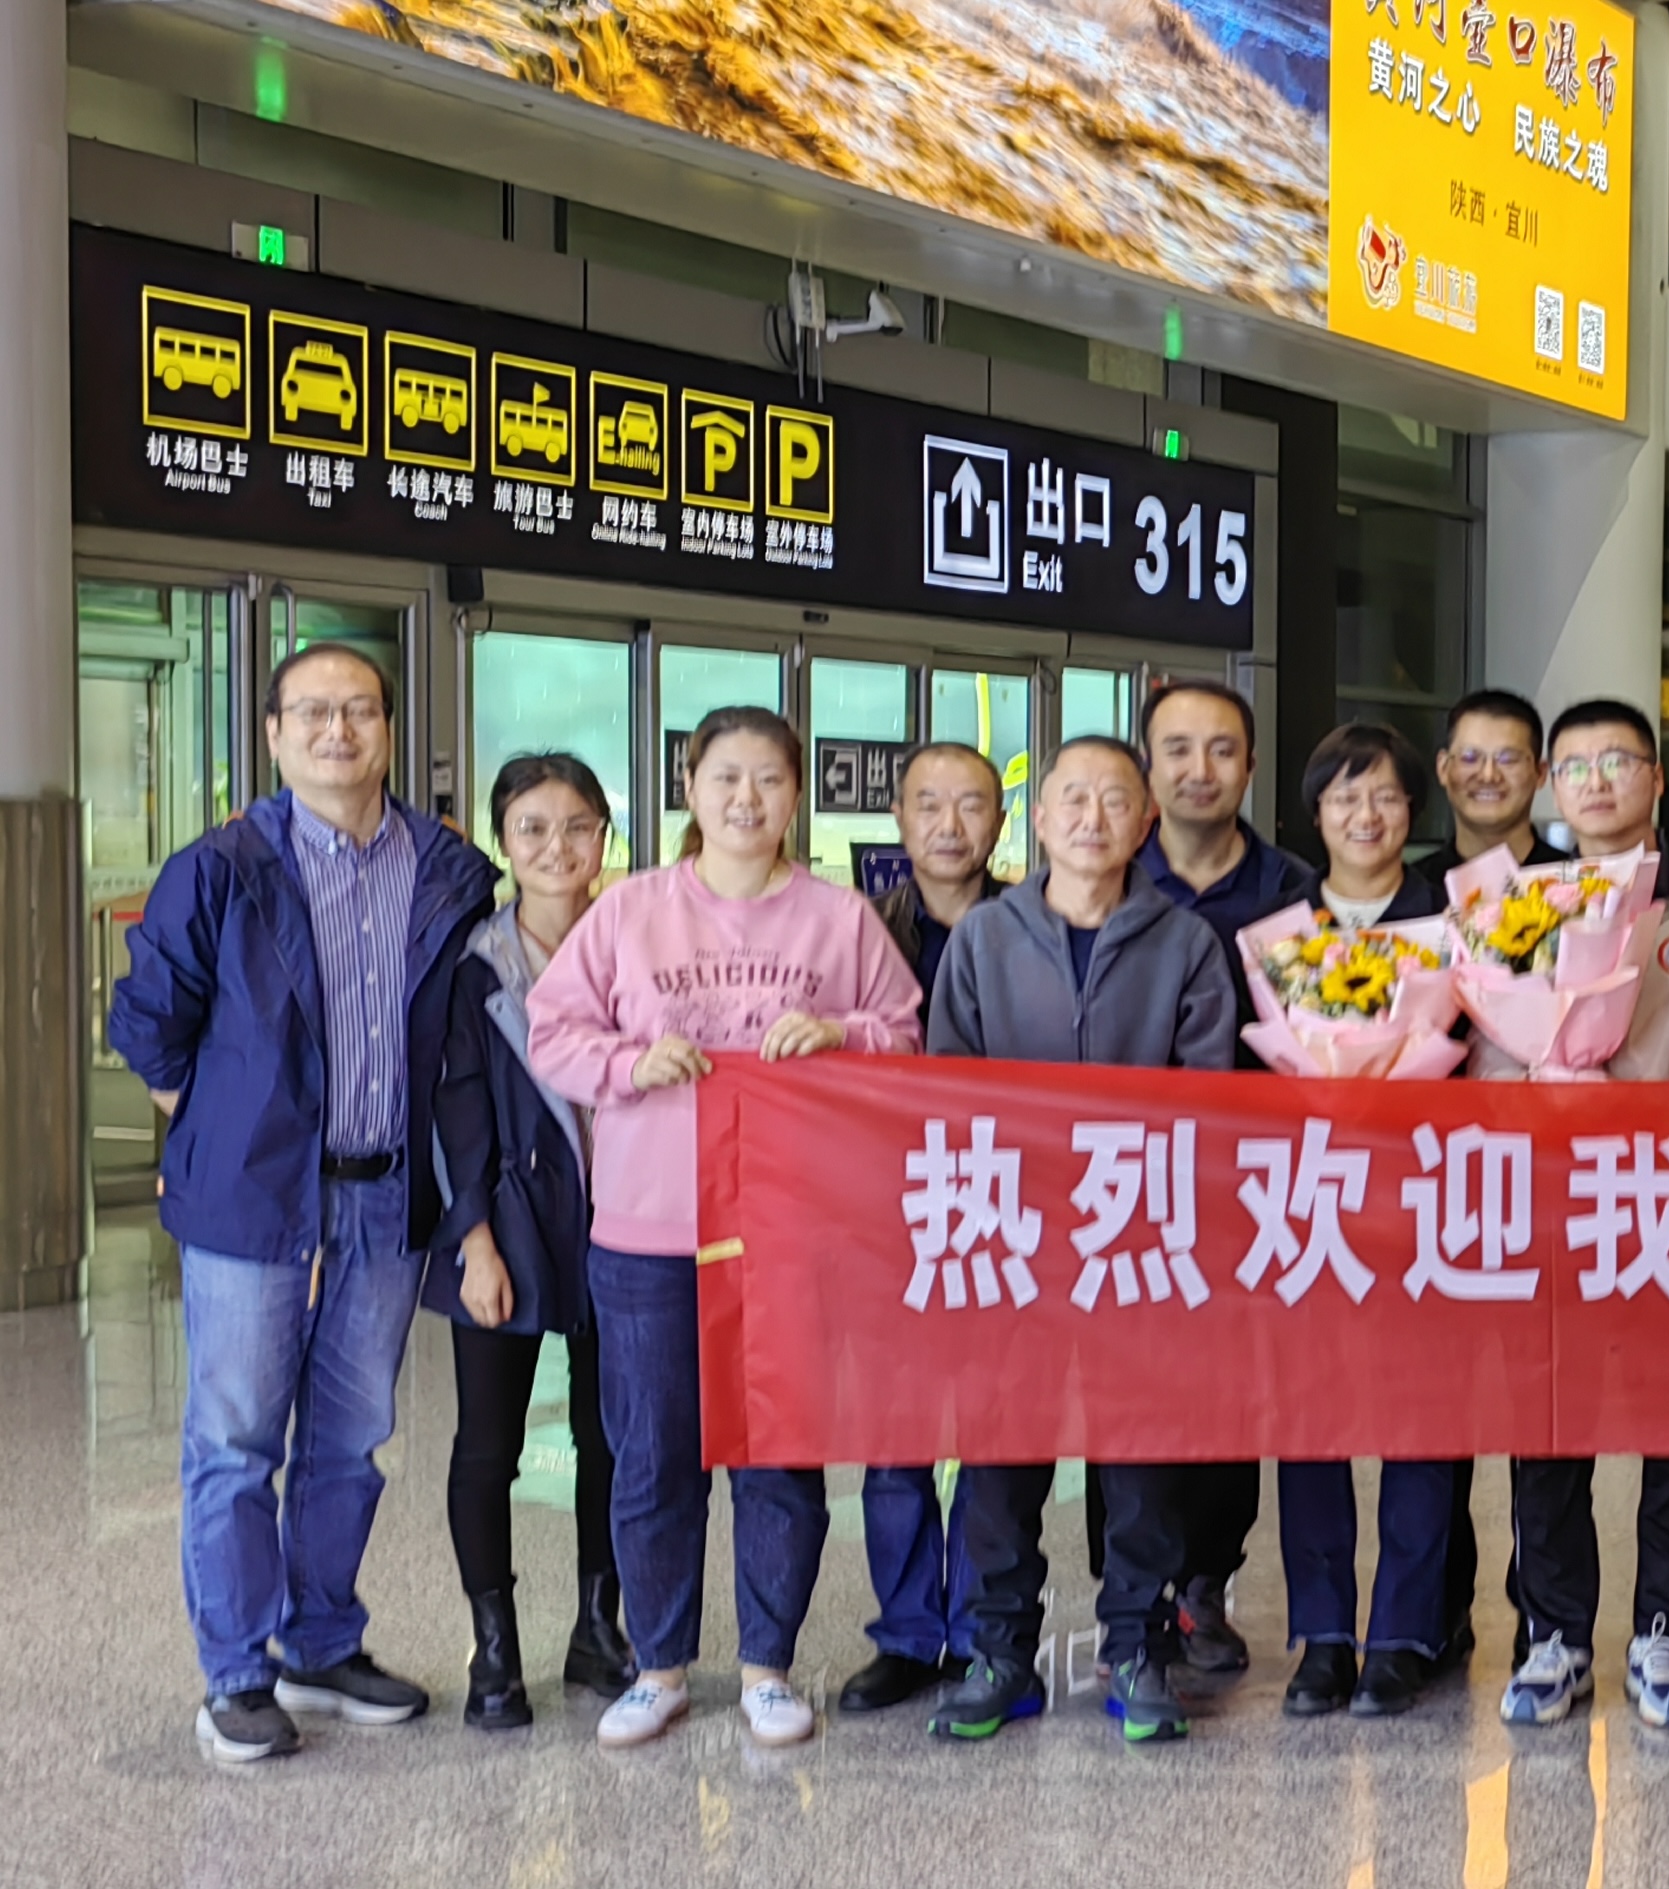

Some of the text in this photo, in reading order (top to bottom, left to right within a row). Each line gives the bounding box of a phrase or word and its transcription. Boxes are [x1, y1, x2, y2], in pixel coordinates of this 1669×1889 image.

[1368, 37, 1609, 192] 黄河之心 民族之魂
[146, 431, 249, 478] 机场巴士
[286, 451, 355, 492] 出租车
[704, 426, 737, 492] P
[779, 419, 821, 507] P
[164, 468, 232, 495] Airport Bus
[307, 487, 332, 508] Taxi
[387, 464, 474, 508] 长途汽车
[493, 480, 574, 520] 旅游巴士
[1027, 457, 1110, 547] 出口
[414, 501, 449, 521] Coach
[513, 512, 556, 535] Tour Bus
[602, 495, 657, 531] 网约车
[681, 506, 755, 544] 室内停车场
[765, 518, 834, 554] 室外停车场
[1134, 495, 1247, 605] 315
[1023, 550, 1063, 592] Exit
